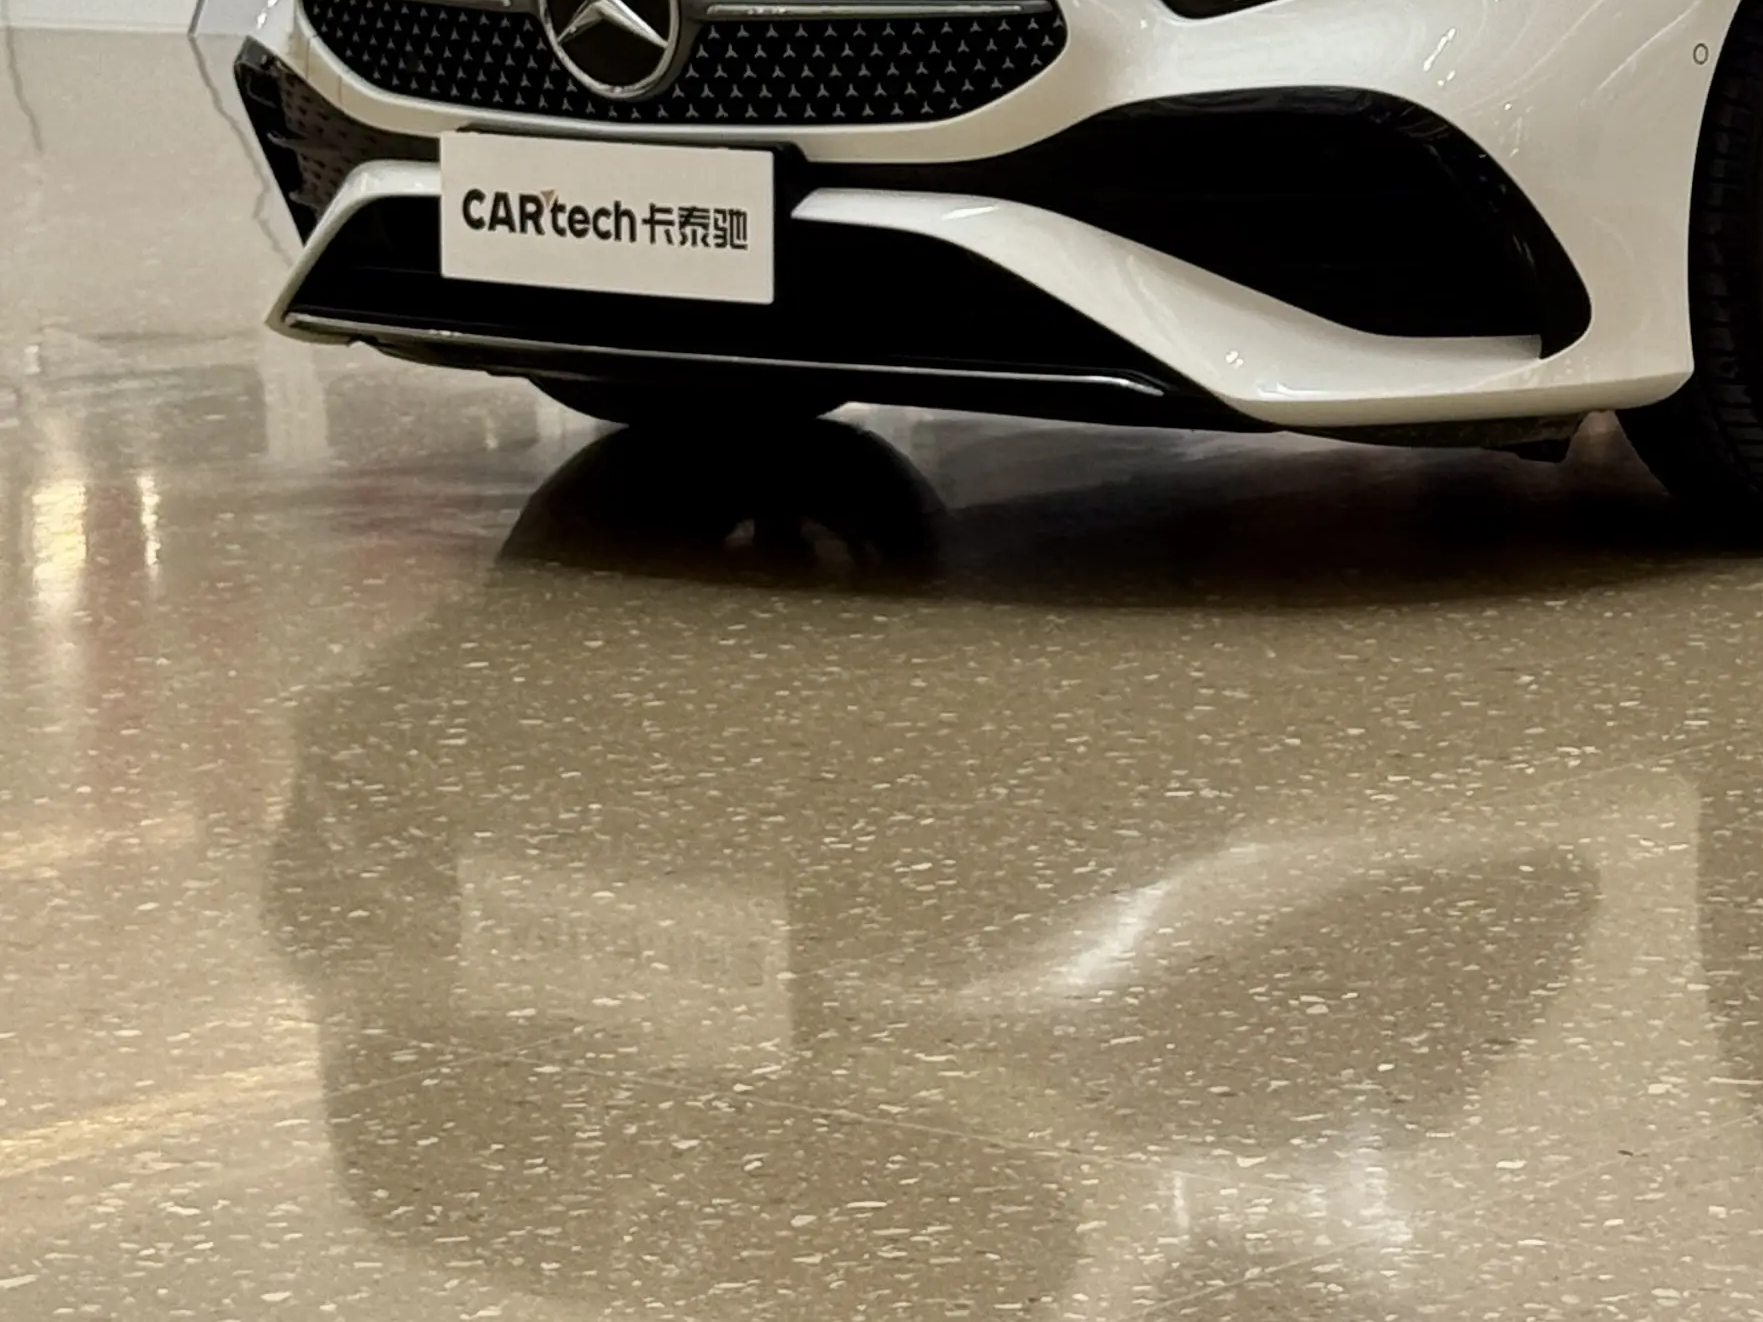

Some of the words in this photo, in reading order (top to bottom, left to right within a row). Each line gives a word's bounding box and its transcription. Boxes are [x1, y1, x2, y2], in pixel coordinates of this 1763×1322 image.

[461, 188, 637, 243] CARtech
[641, 202, 748, 251] 卡泰驰
